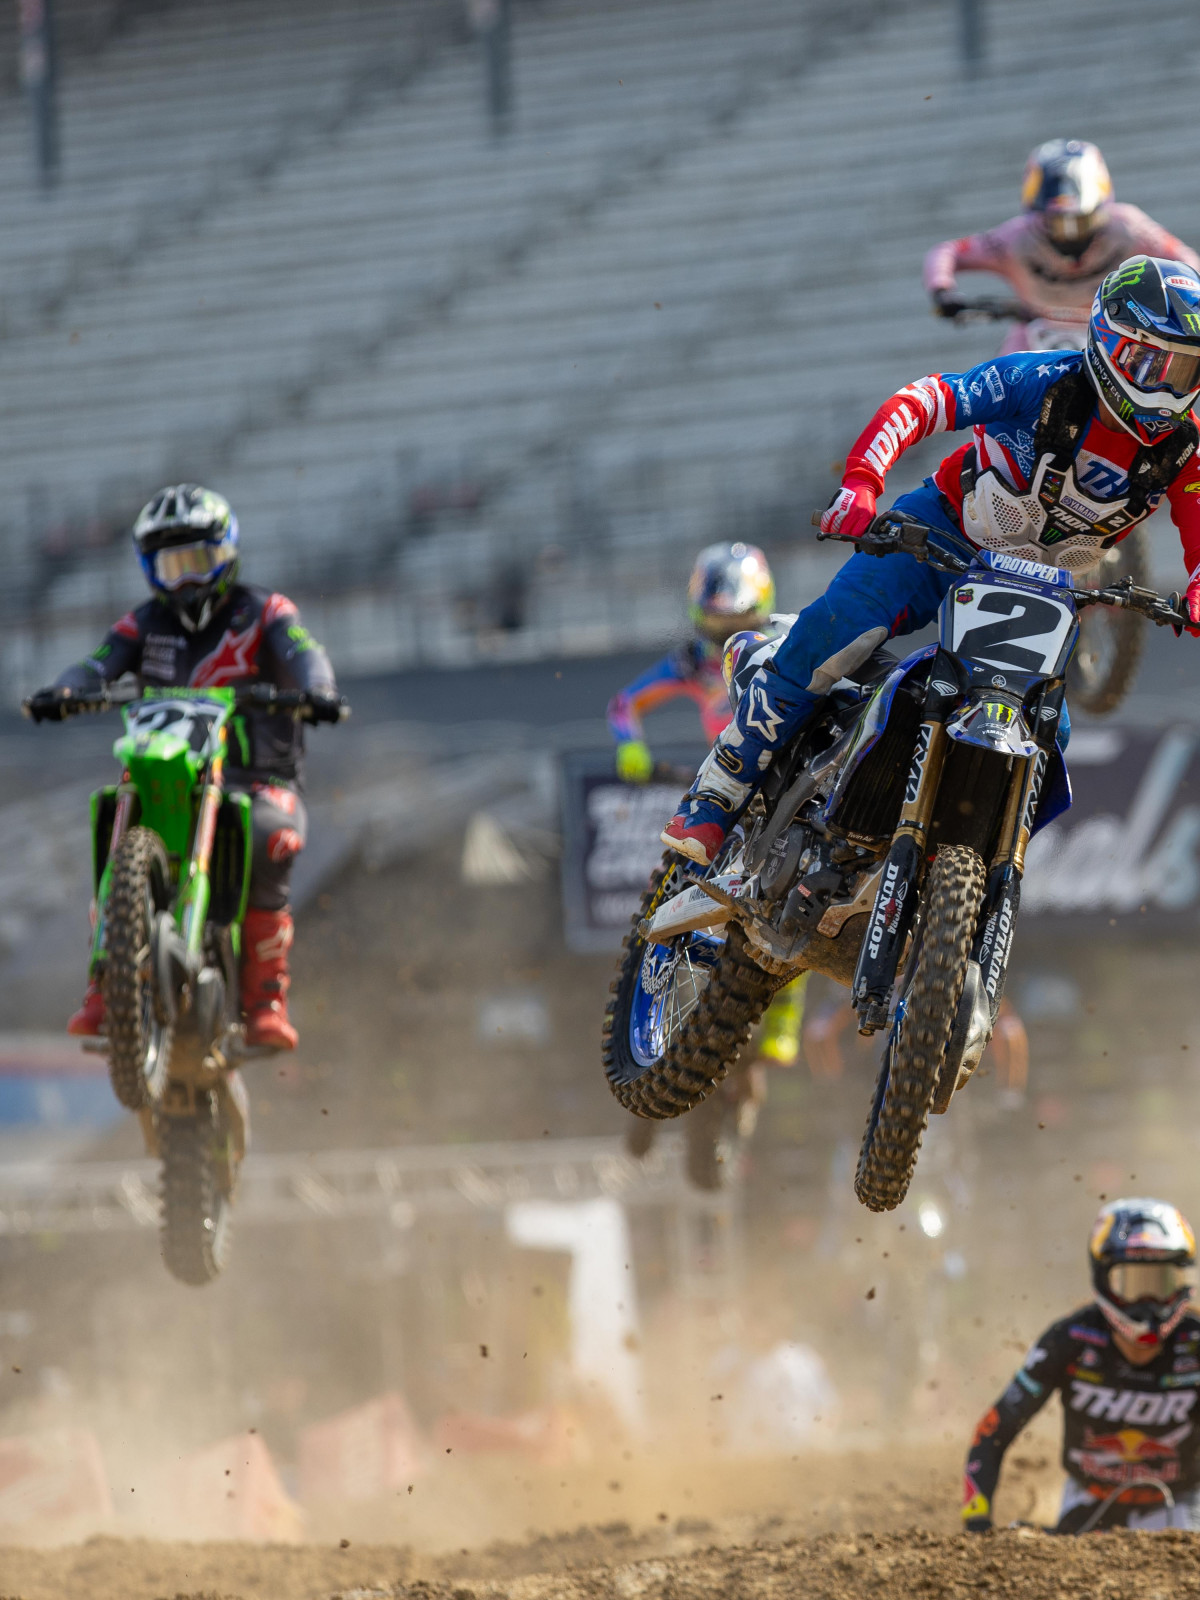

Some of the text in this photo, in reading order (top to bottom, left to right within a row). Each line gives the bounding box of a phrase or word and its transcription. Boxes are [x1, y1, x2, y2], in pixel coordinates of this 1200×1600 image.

[1170, 277, 1196, 287] BELL
[1090, 349, 1121, 402] MONSTER
[1175, 442, 1196, 468] THOR
[841, 492, 854, 512] THOR
[1070, 500, 1099, 522] YAMAHA
[1048, 506, 1091, 532] THOR
[1107, 516, 1126, 528] 2
[993, 554, 1057, 583] PROTAPER
[957, 592, 1062, 673] 2
[870, 862, 900, 960] DUNLOP
[985, 899, 1012, 998] DUNLOP
[1071, 1381, 1197, 1426] THOR
